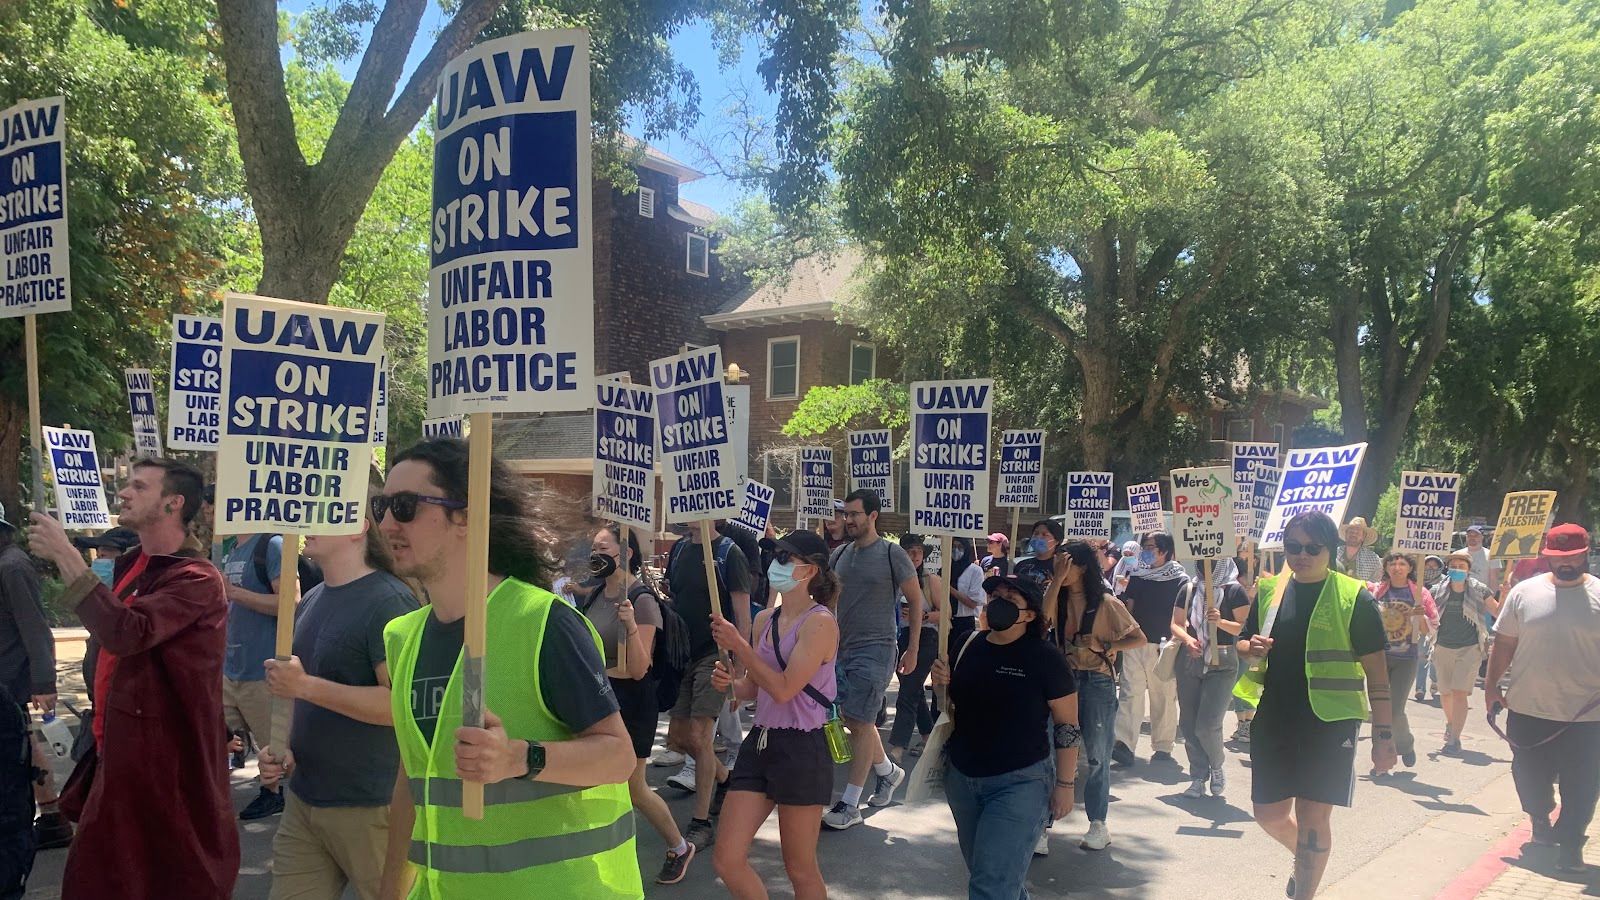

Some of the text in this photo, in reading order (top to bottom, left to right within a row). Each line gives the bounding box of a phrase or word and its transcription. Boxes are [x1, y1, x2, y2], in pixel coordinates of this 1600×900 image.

[437, 45, 575, 130] UAW
[458, 126, 511, 185] ON
[12, 152, 35, 186] ON
[0, 184, 60, 223] STRIKE
[434, 185, 571, 254] STRIKE
[4, 226, 53, 256] UNFAIR
[7, 253, 51, 280] LABOR
[441, 260, 552, 308] UNFAIR
[178, 319, 223, 342] UA
[235, 308, 379, 355] UAW
[444, 307, 546, 352] LABOR
[202, 348, 221, 368] O
[177, 368, 219, 389] STR
[275, 360, 330, 396] ON
[432, 352, 577, 399] PRACTICE
[653, 352, 716, 389] UAW
[127, 373, 150, 389] UAW
[135, 396, 148, 411] ON
[186, 394, 220, 410] UNF
[597, 384, 654, 413] UAW
[678, 391, 701, 418] ON
[917, 385, 989, 410] UAW
[188, 411, 219, 426] LAB
[232, 395, 367, 436] STRIKE
[173, 427, 219, 443] PRAC
[425, 420, 462, 437] UAW
[614, 416, 637, 438] ON
[663, 416, 725, 447] STRIKE
[936, 418, 961, 440] ON
[48, 431, 90, 448] UAW
[850, 432, 888, 446] UAW
[1004, 432, 1042, 444] UAW
[245, 441, 349, 471] UNFAIR
[599, 436, 652, 465] STRIKE
[802, 449, 831, 460] UAW
[862, 449, 878, 461] ON
[917, 443, 984, 466] STRIKE
[1013, 448, 1030, 460] ON
[1235, 446, 1277, 456] UAW
[1290, 447, 1360, 467] UAW
[64, 453, 82, 467] ON
[673, 449, 720, 472] UNFAIR
[1002, 460, 1040, 472] STRIKE
[56, 467, 98, 483] STRIKE
[605, 464, 646, 487] UNFAIR
[812, 463, 825, 474] ON
[853, 462, 890, 475] STRIKE
[1304, 469, 1333, 484] ON
[249, 470, 341, 497] LABOR
[678, 470, 720, 492] LABOR
[803, 475, 832, 487] STRIKE
[858, 479, 886, 488] UNFAIR
[924, 473, 974, 491] UNFAIR
[1005, 475, 1035, 484] UNFAIR
[1070, 474, 1111, 485] UAW
[1405, 475, 1457, 489] UAW
[66, 488, 97, 499] UNFAIR
[608, 481, 643, 503] LABOR
[746, 483, 772, 500] AW
[806, 489, 830, 498] UNFAIR
[1006, 485, 1033, 493] LABOR
[1081, 487, 1098, 497] ON
[1129, 484, 1158, 494] UAW
[1264, 486, 1276, 497] ON
[1280, 482, 1348, 502] STRIKE
[71, 501, 98, 511] LABOR
[670, 489, 735, 513] PRACTICE
[808, 499, 828, 507] LABOR
[925, 491, 971, 510] LABOR
[1000, 494, 1038, 503] PRACTICE
[1069, 499, 1109, 509] STRIKE
[1138, 494, 1151, 503] ON
[1253, 495, 1272, 509] STRI
[1418, 492, 1438, 504] ON
[1505, 494, 1549, 516] FREE
[226, 498, 359, 524] PRACTICE
[597, 497, 651, 523] PRACTICE
[803, 506, 833, 516] PRACTICE
[1132, 502, 1160, 512] STRIKE
[1175, 495, 1219, 518] Praying
[1402, 504, 1453, 518] STRIKE
[66, 513, 108, 523] PRACTICE
[741, 510, 766, 528] RIKE
[914, 509, 984, 530] PRACTICE
[1073, 511, 1104, 519] UNFAIR
[1136, 511, 1158, 519] UNFAIR
[1138, 517, 1157, 525] LABOR
[1187, 517, 1203, 527] for
[1500, 514, 1546, 527] PALESTINE
[1074, 520, 1103, 528] LABOR
[1134, 522, 1163, 531] PRACTICE
[1406, 520, 1445, 531] UNFAIR
[1067, 528, 1109, 537] PRACTICE
[1183, 529, 1224, 546] Living
[1407, 530, 1441, 541] LABOR
[1189, 542, 1222, 558] Wage
[1398, 539, 1448, 551] PRACTICE
